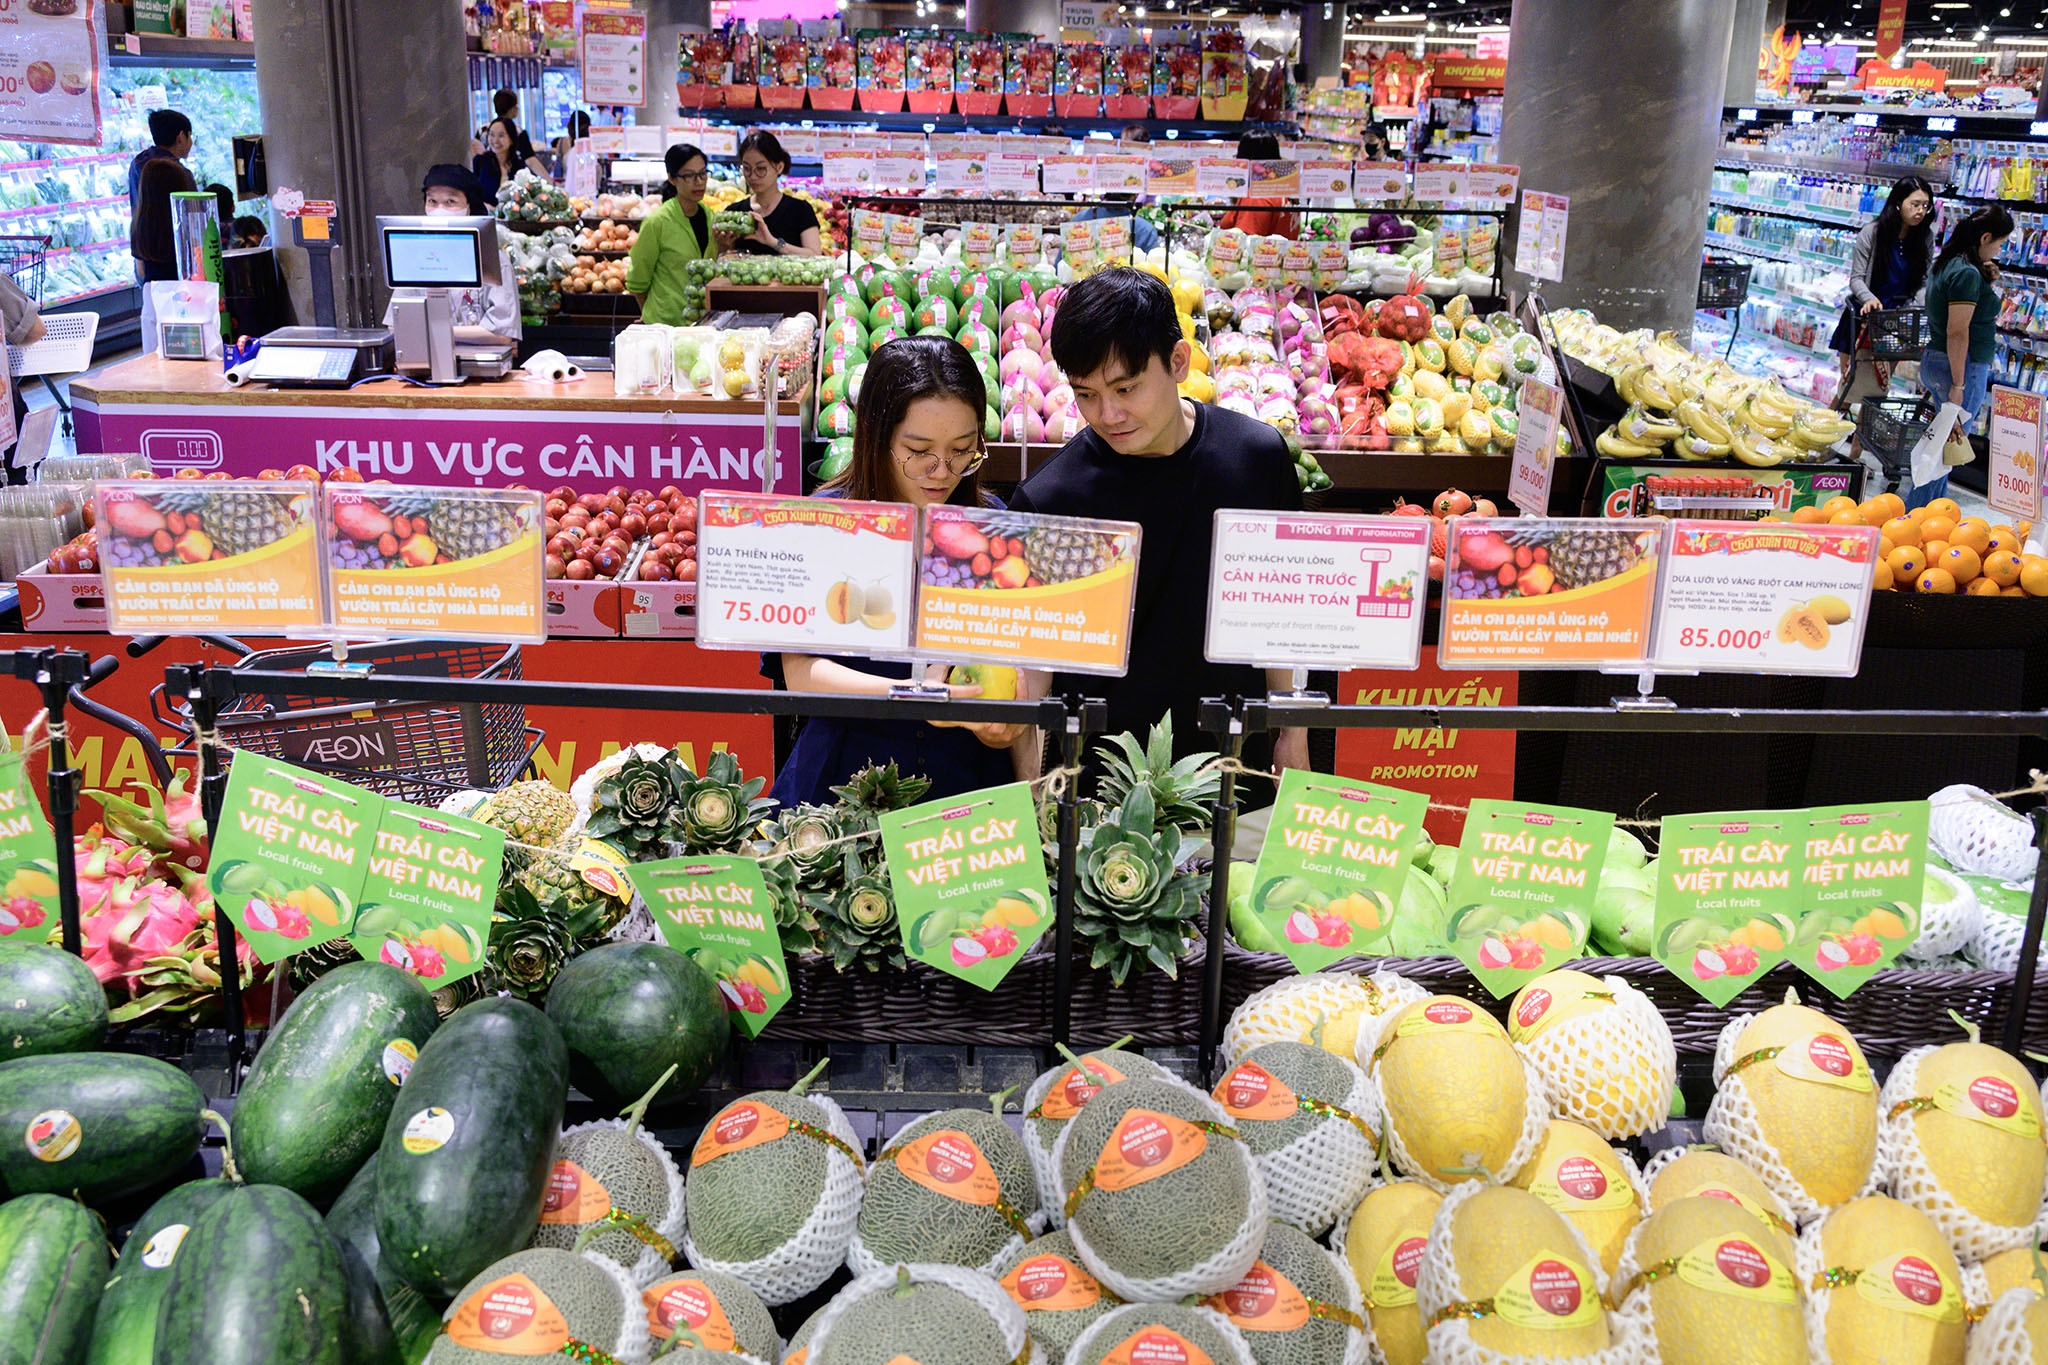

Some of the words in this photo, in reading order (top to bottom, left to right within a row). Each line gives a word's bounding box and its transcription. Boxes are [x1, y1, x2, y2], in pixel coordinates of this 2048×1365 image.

[1444, 64, 1485, 76] KHUYẾN
[1875, 75, 1915, 87] KHUYẾN
[1916, 78, 1934, 89] MẠI
[178, 440, 208, 458] 0.00
[315, 440, 413, 475] KHU
[424, 437, 524, 485] VỰC
[539, 434, 640, 479] CÂN
[650, 436, 784, 481] HÀNG
[1290, 522, 1332, 536] THÔNG
[1336, 524, 1354, 536] TIN
[1362, 530, 1415, 538] INFORMATION
[707, 547, 731, 558] DƯA
[735, 547, 767, 560] THIÊN
[770, 550, 804, 562] HỒNG
[1224, 552, 1246, 564] QUÝ
[1248, 553, 1284, 564] KHÁCH
[1288, 555, 1304, 564] VUI
[1306, 555, 1334, 565] LÒNG
[1223, 568, 1254, 582] CÂN
[1258, 570, 1302, 584] HÀNG
[1306, 570, 1357, 586] TRƯỚC
[1672, 575, 1690, 584] DƯA
[1694, 575, 1714, 585] LƯỚI
[1732, 576, 1756, 586] VÀNG
[1758, 578, 1781, 588] RUỘT
[1784, 580, 1803, 588] CAM
[1839, 582, 1862, 590] LONG
[1222, 591, 1247, 602] KHI
[1252, 592, 1304, 604] THANH
[1308, 592, 1350, 606] TOÁN
[925, 598, 956, 613] CẢM
[958, 604, 978, 616] ƠN
[980, 604, 1010, 620] BẠN
[1012, 605, 1031, 621] ĐÃ
[1065, 610, 1086, 627] HỘ
[1452, 610, 1482, 625] CẢM
[1484, 613, 1504, 626] ƠN
[1506, 614, 1536, 629] BẠN
[1537, 612, 1556, 626] ĐÃ
[1588, 612, 1608, 629] HỘ
[924, 615, 964, 631] VƯỜN
[966, 619, 998, 635] TRÁI
[1000, 621, 1028, 636] CÂY
[1030, 624, 1059, 640] NHÀ
[1061, 630, 1081, 642] EM
[1220, 619, 1248, 628] Please
[1250, 620, 1280, 630] weight
[1282, 621, 1290, 630] of
[1292, 621, 1312, 630] front
[1314, 622, 1338, 631] items
[1340, 624, 1356, 632] pay
[1451, 627, 1490, 642] VƯỜN
[1492, 628, 1524, 643] TRÁI
[1526, 629, 1553, 643] CÂY
[1554, 629, 1582, 644] NHÀ
[1584, 632, 1604, 644] EM
[1355, 677, 1503, 707] KHUYẾN
[1393, 728, 1459, 756] MẠI
[1371, 764, 1478, 780] PROMOTION
[248, 786, 305, 821] TRÁI
[310, 808, 359, 838] CÂY
[1294, 803, 1351, 830] TRÁI
[1354, 814, 1406, 842] CÂY
[238, 804, 295, 842] VIỆT
[299, 834, 355, 865] NAM
[904, 827, 964, 860] TRÁI
[969, 818, 1018, 845] CÂY
[1480, 830, 1535, 855] TRÁI
[1540, 836, 1592, 861] CÂY
[376, 831, 431, 859] TRÁI
[437, 847, 484, 876] CÂY
[1283, 826, 1338, 856] VIỆT
[1342, 841, 1400, 868] NAM
[1679, 842, 1734, 866] TRÁI
[1740, 839, 1791, 864] CÂY
[257, 845, 289, 864] Local
[292, 856, 324, 876] fruits
[906, 858, 962, 886] VIỆT
[968, 844, 1026, 872] NAM
[1301, 859, 1333, 874] Local
[1335, 867, 1367, 882] fruits
[1470, 855, 1525, 884] VIỆT
[1529, 862, 1587, 889] NAM
[369, 855, 422, 884] VIỆT
[427, 872, 482, 902] NAM
[938, 885, 969, 899] Local
[973, 876, 1005, 891] fruits
[1673, 869, 1727, 896] VIỆT
[1732, 868, 1790, 889] NAM
[388, 887, 419, 905] Local
[422, 897, 453, 914] fruits
[658, 881, 713, 902] TRÁI
[715, 881, 754, 906] CÂY
[1490, 886, 1521, 899] Local
[1524, 889, 1555, 903] fruits
[1696, 897, 1726, 909] Local
[1729, 897, 1761, 909] fruits
[666, 905, 714, 928] VIỆT
[722, 908, 766, 932] NAM
[701, 932, 724, 943] Local
[726, 934, 751, 946] fruits
[1246, 1082, 1268, 1090] MELON
[1142, 1128, 1168, 1141] MELON
[1554, 1280, 1578, 1288] MELON
